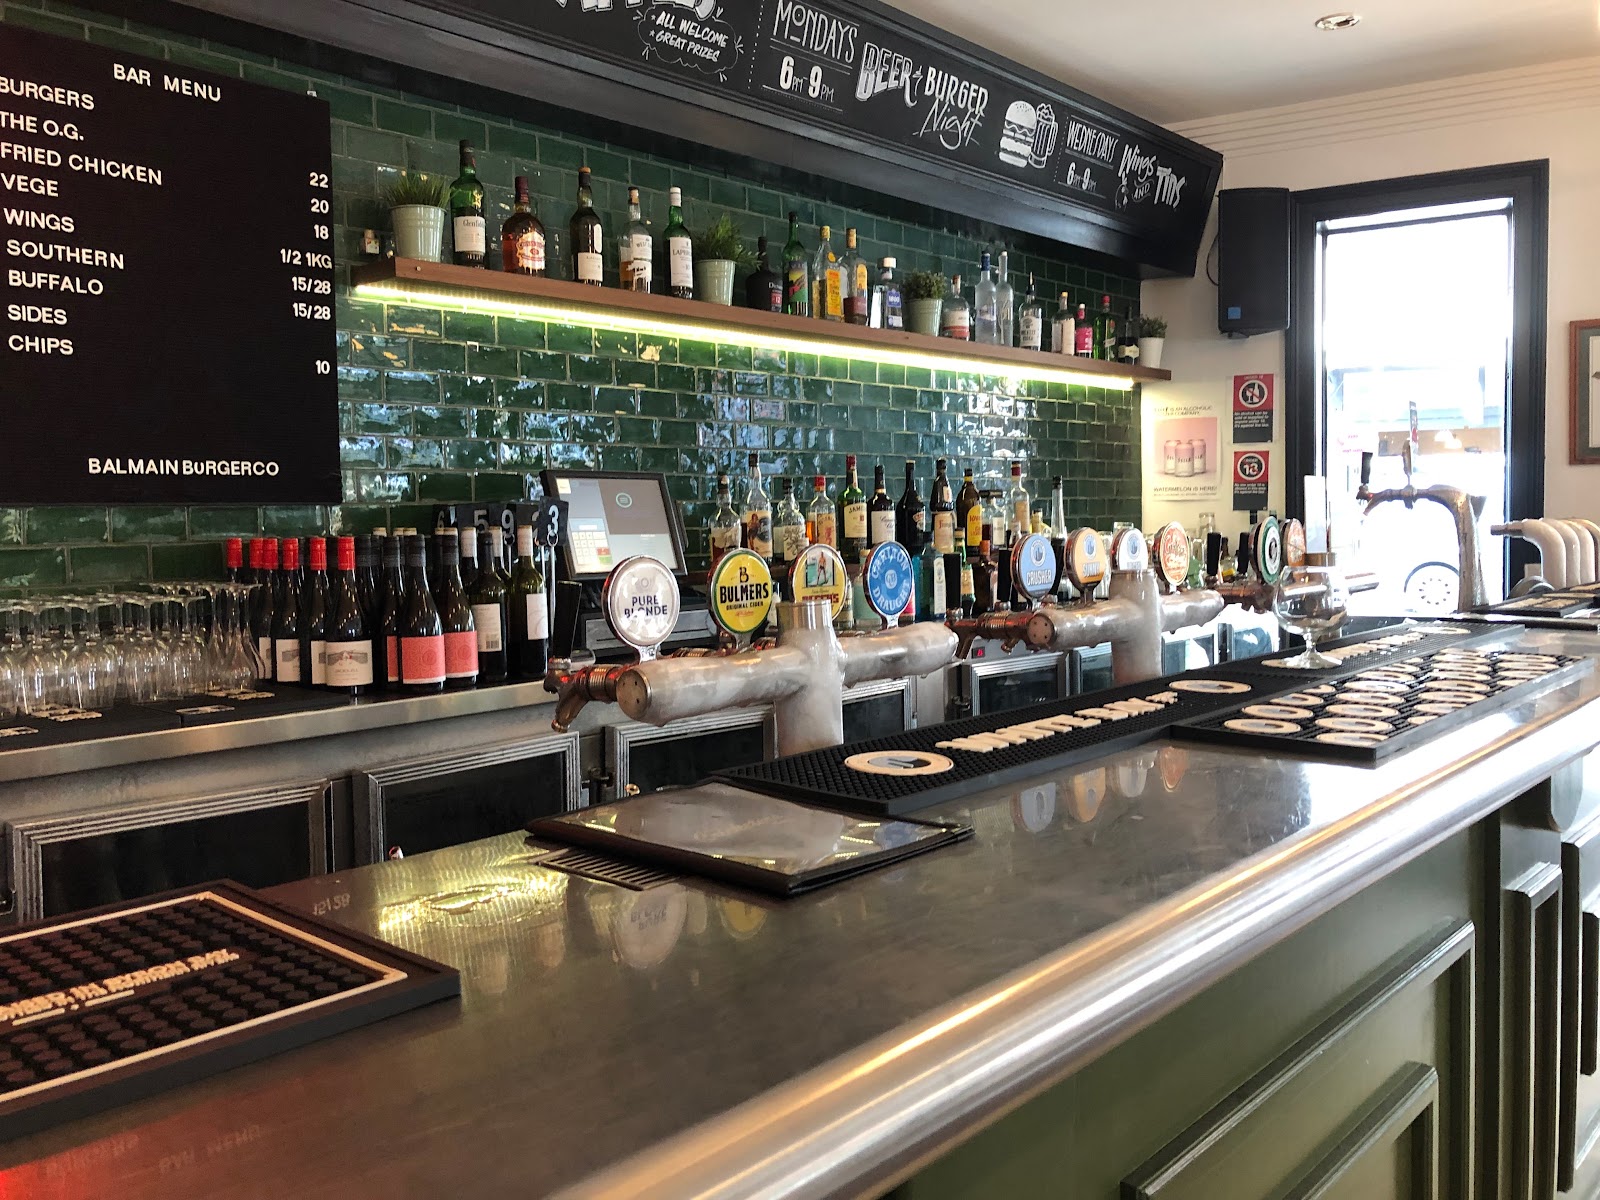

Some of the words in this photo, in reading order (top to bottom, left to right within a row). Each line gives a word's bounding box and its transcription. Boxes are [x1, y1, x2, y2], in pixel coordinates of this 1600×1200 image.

[655, 11, 675, 30] ALL
[679, 18, 729, 48] WELCOME
[773, 0, 858, 63] MONDAYS
[655, 30, 688, 51] GREAT
[687, 41, 721, 62] PRIZES
[113, 63, 151, 87] BAR
[163, 74, 221, 102] MENU
[855, 42, 918, 108] BEER
[924, 66, 989, 117] BURGER
[0, 76, 95, 110] BURGERS
[0, 111, 37, 133] THE
[42, 119, 84, 141] O.G.
[913, 98, 983, 150] Night
[0, 142, 62, 167] FRIED
[68, 154, 163, 186] CHICKEN
[1118, 144, 1157, 182] Wings
[0, 173, 59, 198] VEGE
[309, 171, 329, 189] 22
[310, 197, 330, 214] 20
[3, 207, 75, 233] WINGS
[313, 224, 329, 240] 18
[6, 239, 125, 270] SOUTHERN
[280, 248, 302, 266] 1/2
[305, 251, 333, 269] 1KG
[8, 269, 104, 296] BUFFALO
[291, 276, 332, 295] 15/28
[7, 304, 68, 326] SIDES
[292, 302, 331, 321] 15/28
[8, 334, 74, 356] CHIPS
[315, 359, 331, 375] 10
[88, 457, 179, 475] BALMAIN
[1243, 463, 1259, 476] 18
[473, 509, 489, 535] 5
[501, 509, 515, 539] 9
[547, 504, 559, 536] 3
[871, 545, 910, 580] CARLTON
[1026, 568, 1052, 586] CRUSHER
[632, 595, 659, 607] PURE
[720, 582, 769, 604] BULMERS
[872, 576, 912, 612] DRAUGHT
